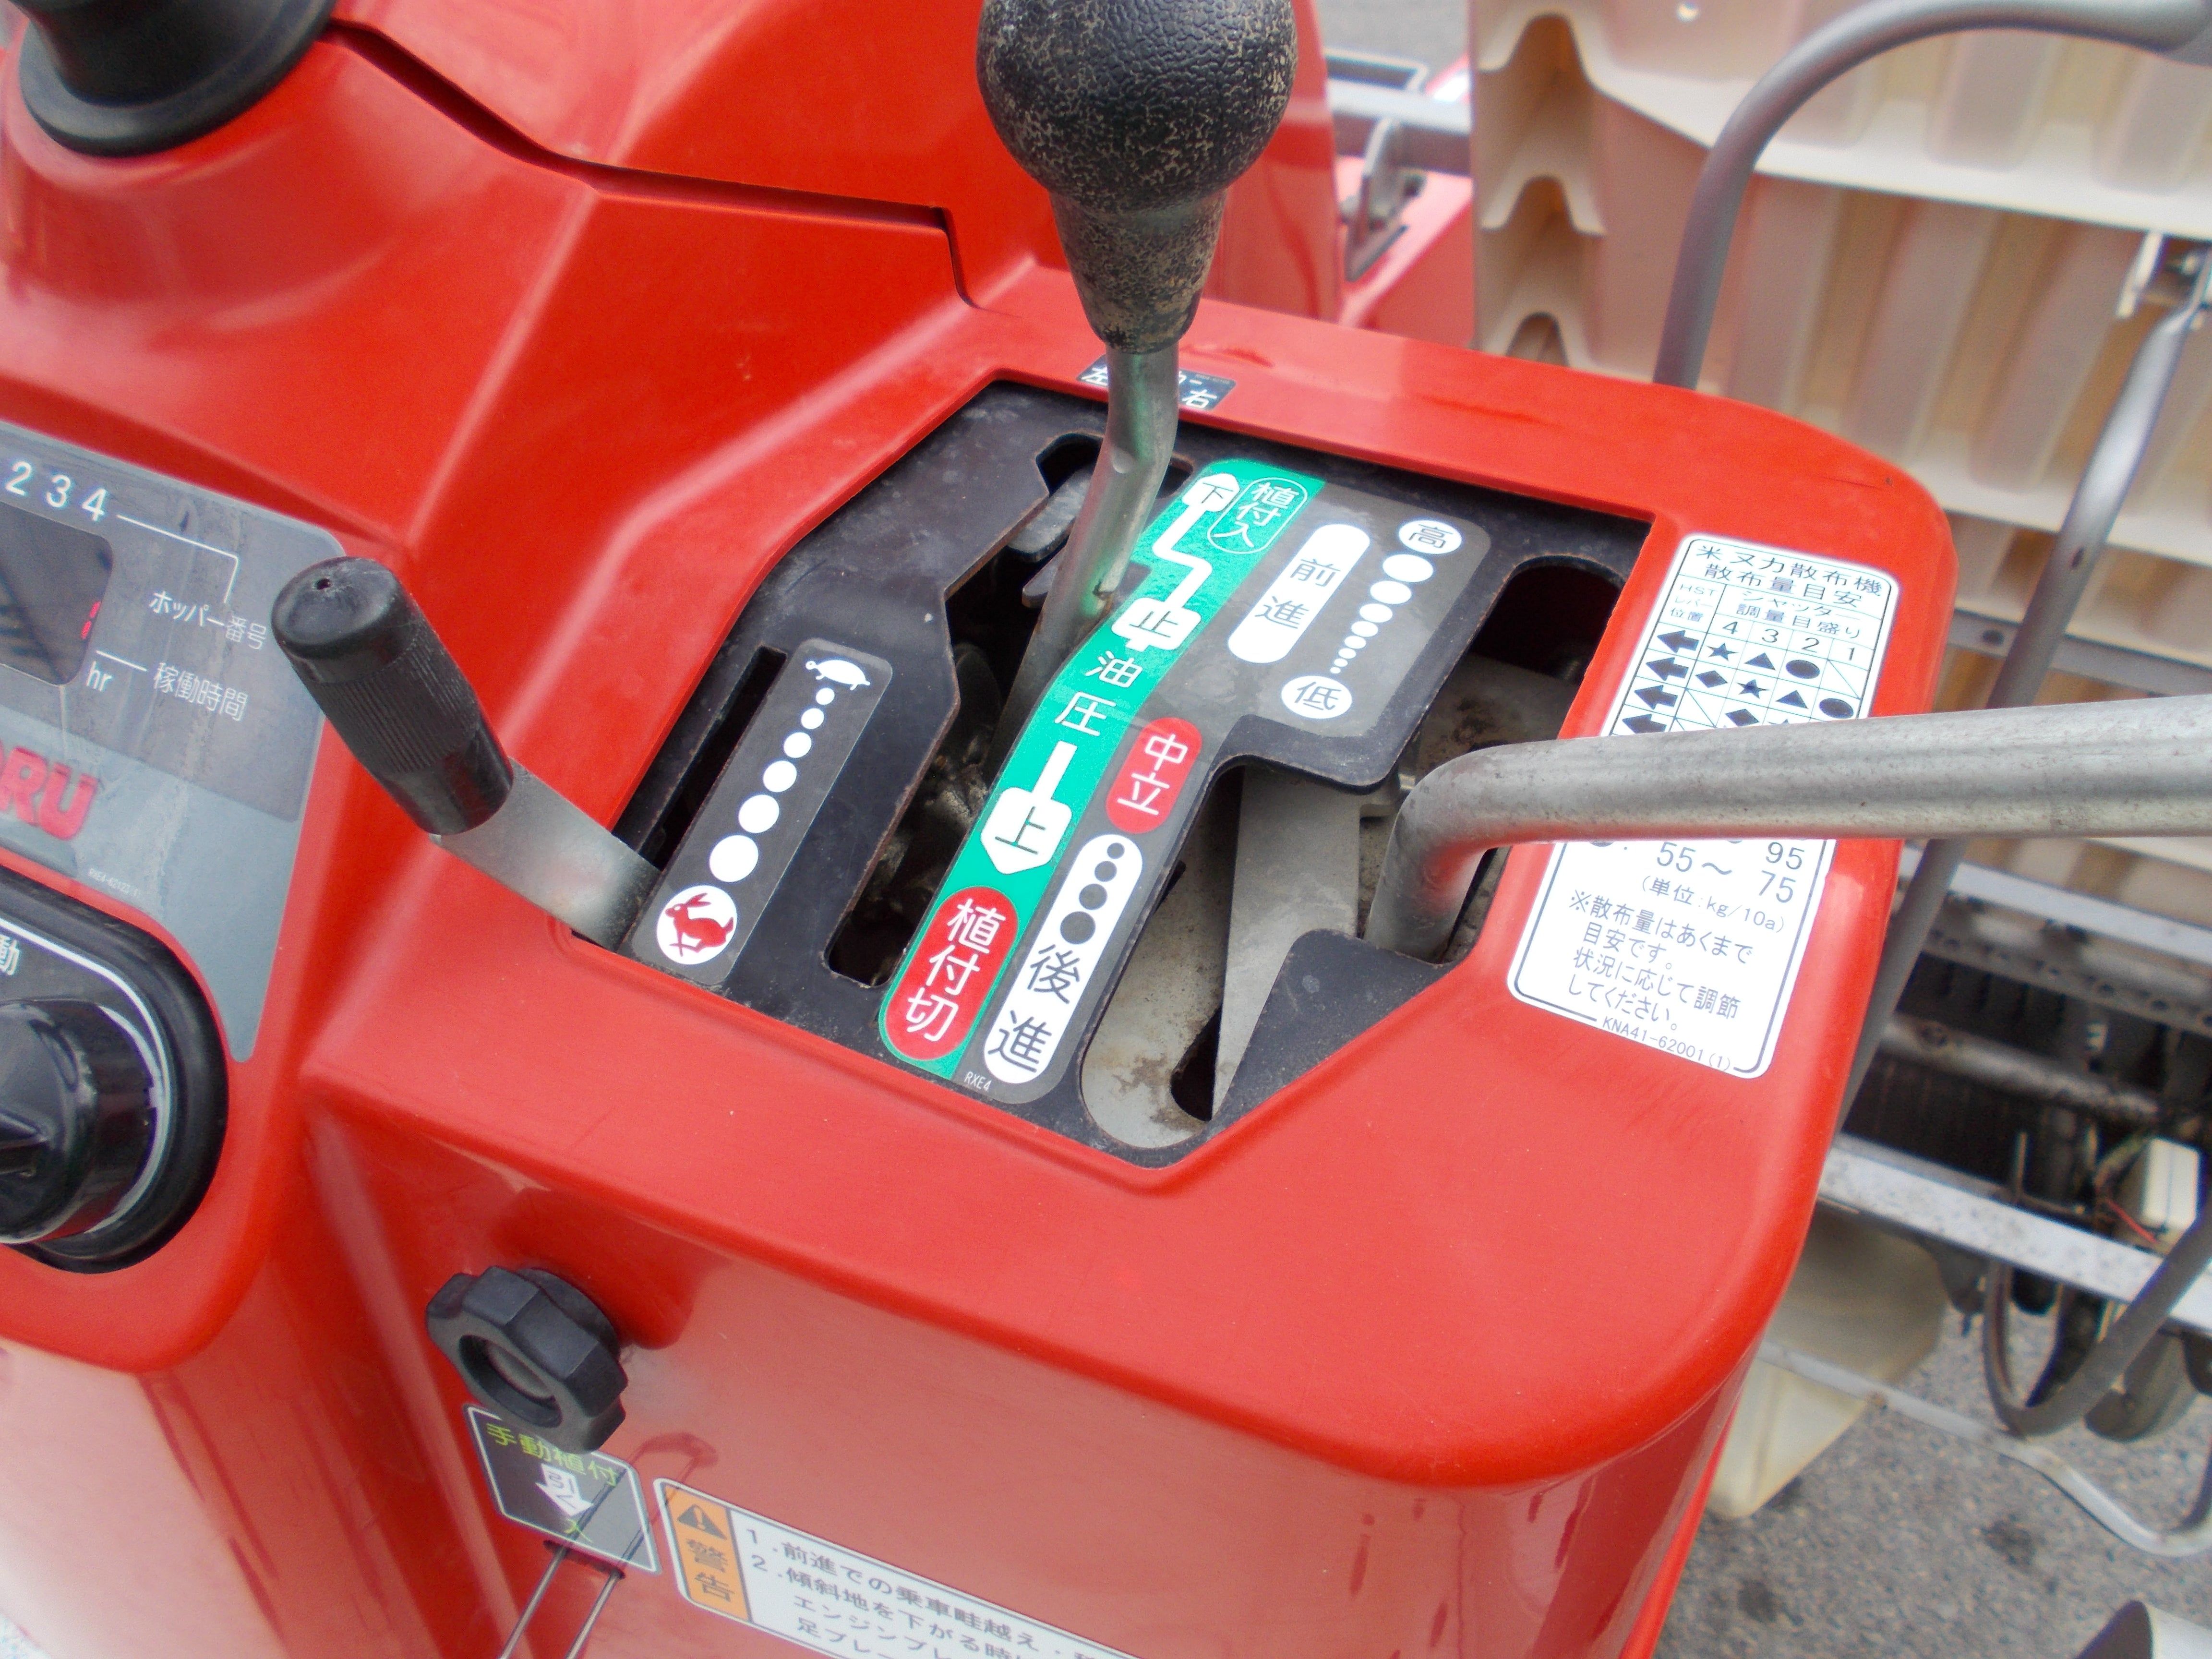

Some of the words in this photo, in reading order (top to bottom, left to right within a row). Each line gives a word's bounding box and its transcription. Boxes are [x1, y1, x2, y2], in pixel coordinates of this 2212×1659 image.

[1181, 389, 1217, 409] 右
[5, 461, 32, 496] 2
[46, 474, 72, 508] 3
[82, 488, 107, 521] 4
[1202, 481, 1235, 504] 下
[1213, 482, 1299, 548] 植付入
[1408, 523, 1454, 549] 高
[1254, 557, 1342, 629] 前進
[1679, 583, 1718, 597] HST
[1696, 545, 1883, 597] 米ヌカ散布機
[1704, 563, 1862, 608] 散布量目安
[149, 590, 267, 650] ホッパー番号
[1130, 609, 1178, 638] 止
[1670, 607, 1703, 622] 位置
[1675, 595, 1713, 608] レバー
[1736, 603, 1860, 639] 調量目盛り
[1742, 590, 1861, 621] シャッター
[1722, 621, 1739, 635] 4
[1761, 628, 1779, 643] 3
[1800, 637, 1820, 653] 2
[1848, 647, 1856, 661] 1
[86, 661, 113, 692] hr
[153, 662, 248, 721] 稼働時間
[1055, 650, 1143, 737] 油圧
[1296, 681, 1342, 711] 低
[1117, 734, 1189, 816] 中立
[994, 805, 1046, 855] 上
[1765, 841, 1805, 870] 95
[1758, 870, 1796, 903] 75
[1569, 889, 1754, 964] ※散布量はあくまで
[1583, 921, 1672, 970] 目安です。
[905, 898, 1006, 1042] 植付切
[1573, 946, 1742, 1020] 状況に応じて調節
[988, 944, 1081, 1073] 後進
[1568, 974, 1678, 1031] してください。
[964, 1071, 992, 1092] RXE4
[685, 1538, 735, 1602] 警告
